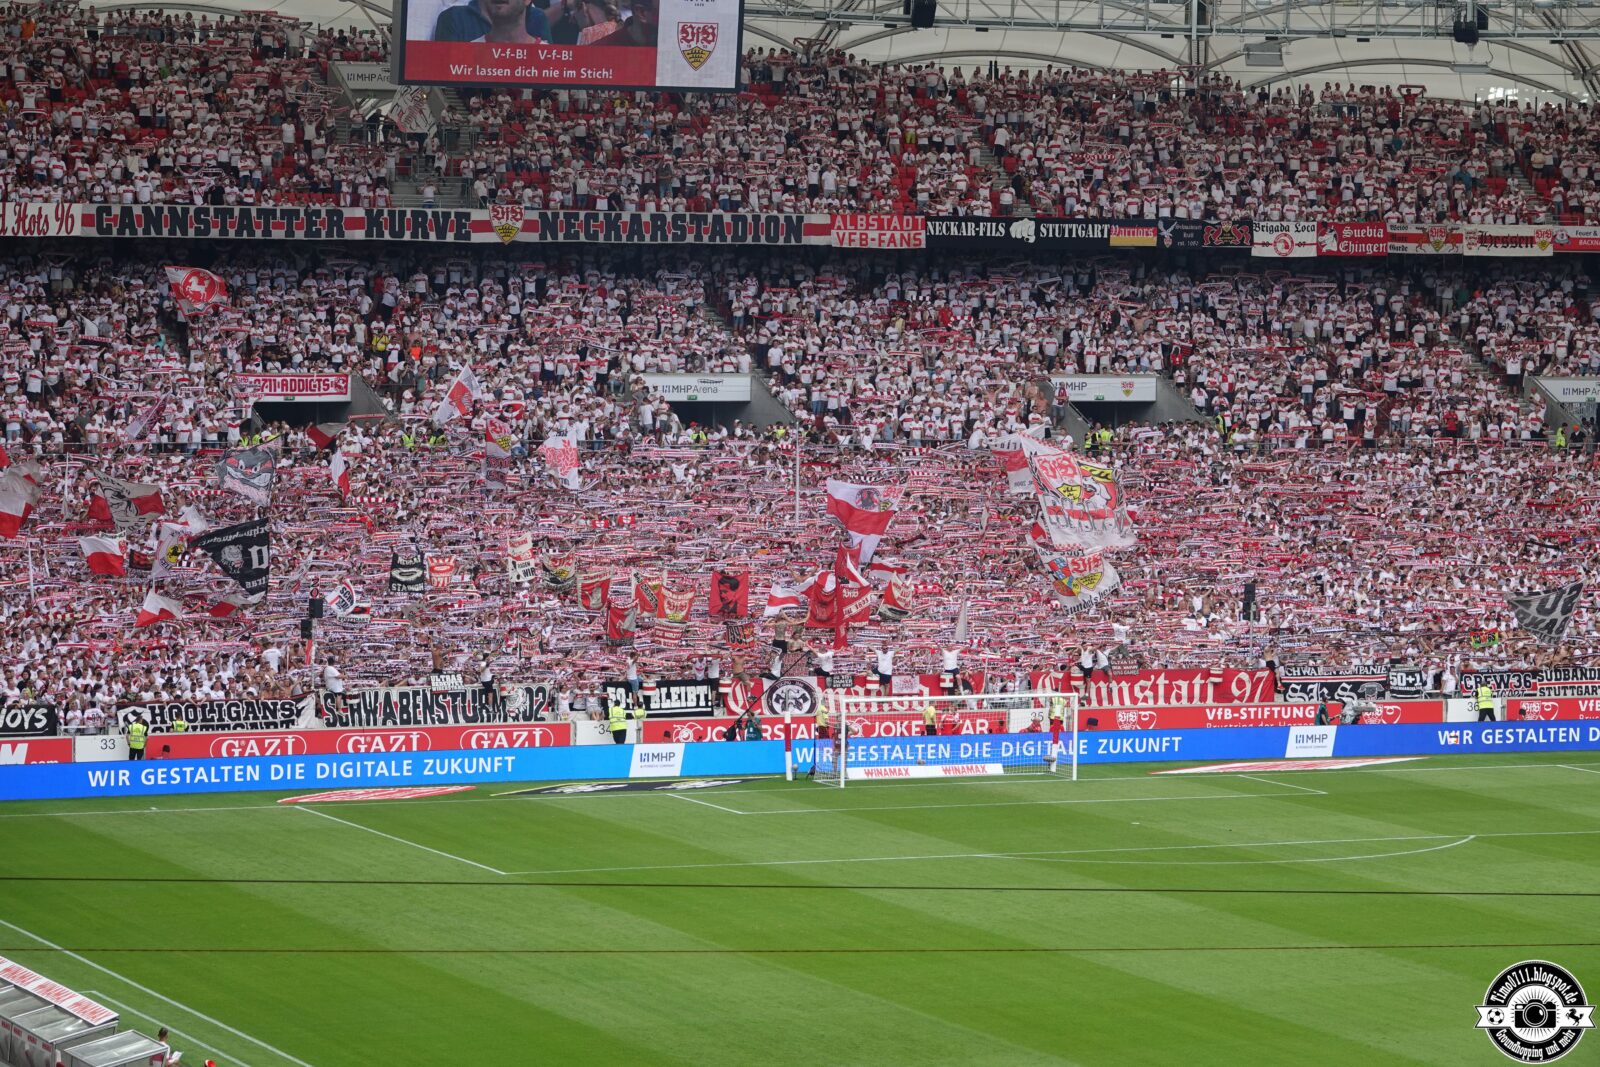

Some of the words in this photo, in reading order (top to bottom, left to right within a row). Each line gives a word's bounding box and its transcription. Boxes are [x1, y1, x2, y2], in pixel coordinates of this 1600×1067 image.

[492, 49, 528, 60] V-f-B!
[538, 49, 574, 61] V-f-B!
[356, 73, 376, 81] MHP
[450, 64, 473, 75] Wir
[476, 65, 511, 77] lassen
[515, 65, 538, 77] dich
[542, 66, 559, 77] nie
[563, 67, 576, 78] im
[580, 67, 613, 79] Stich!
[95, 206, 345, 239] CANNSTATTER
[365, 208, 472, 242] KURVE
[539, 210, 804, 244] NECKARSTADION
[833, 214, 926, 231] ALBSTADT
[1252, 221, 1290, 233] Brigada
[1294, 221, 1316, 232] Loca
[926, 221, 1006, 237] NECKAR-FILS
[1039, 223, 1110, 239] STUTTGART
[1342, 226, 1384, 239] Suebia
[836, 231, 923, 248] VFB-FANS
[671, 384, 692, 393] MHP
[693, 385, 718, 394] Arena
[1065, 381, 1088, 391] MHP
[1571, 388, 1591, 396] MHP
[1389, 672, 1422, 687] 50+1
[1231, 671, 1270, 704] 97
[522, 686, 547, 722] 02
[650, 685, 712, 709] BLEIBT!
[149, 700, 296, 725] HOOLIGANS
[1205, 706, 1315, 720] VfB-STIFTUNG
[1306, 734, 1329, 744] MHP
[1481, 726, 1581, 745] GESTALTEN
[100, 738, 116, 750] 33
[847, 742, 950, 762] GESTALTEN
[960, 741, 992, 758] DIE
[1001, 739, 1088, 757] DIGITALE
[1097, 736, 1182, 754] ZUKUNFT
[652, 752, 676, 762] MHP
[88, 769, 131, 787] WIR
[142, 763, 260, 786] GESTALTEN
[271, 762, 305, 780] DIE
[316, 759, 413, 779] DIGITALE
[423, 756, 516, 776] ZUKUNFT
[864, 767, 911, 777] WINAMAX
[942, 764, 988, 775] WINAMAX
